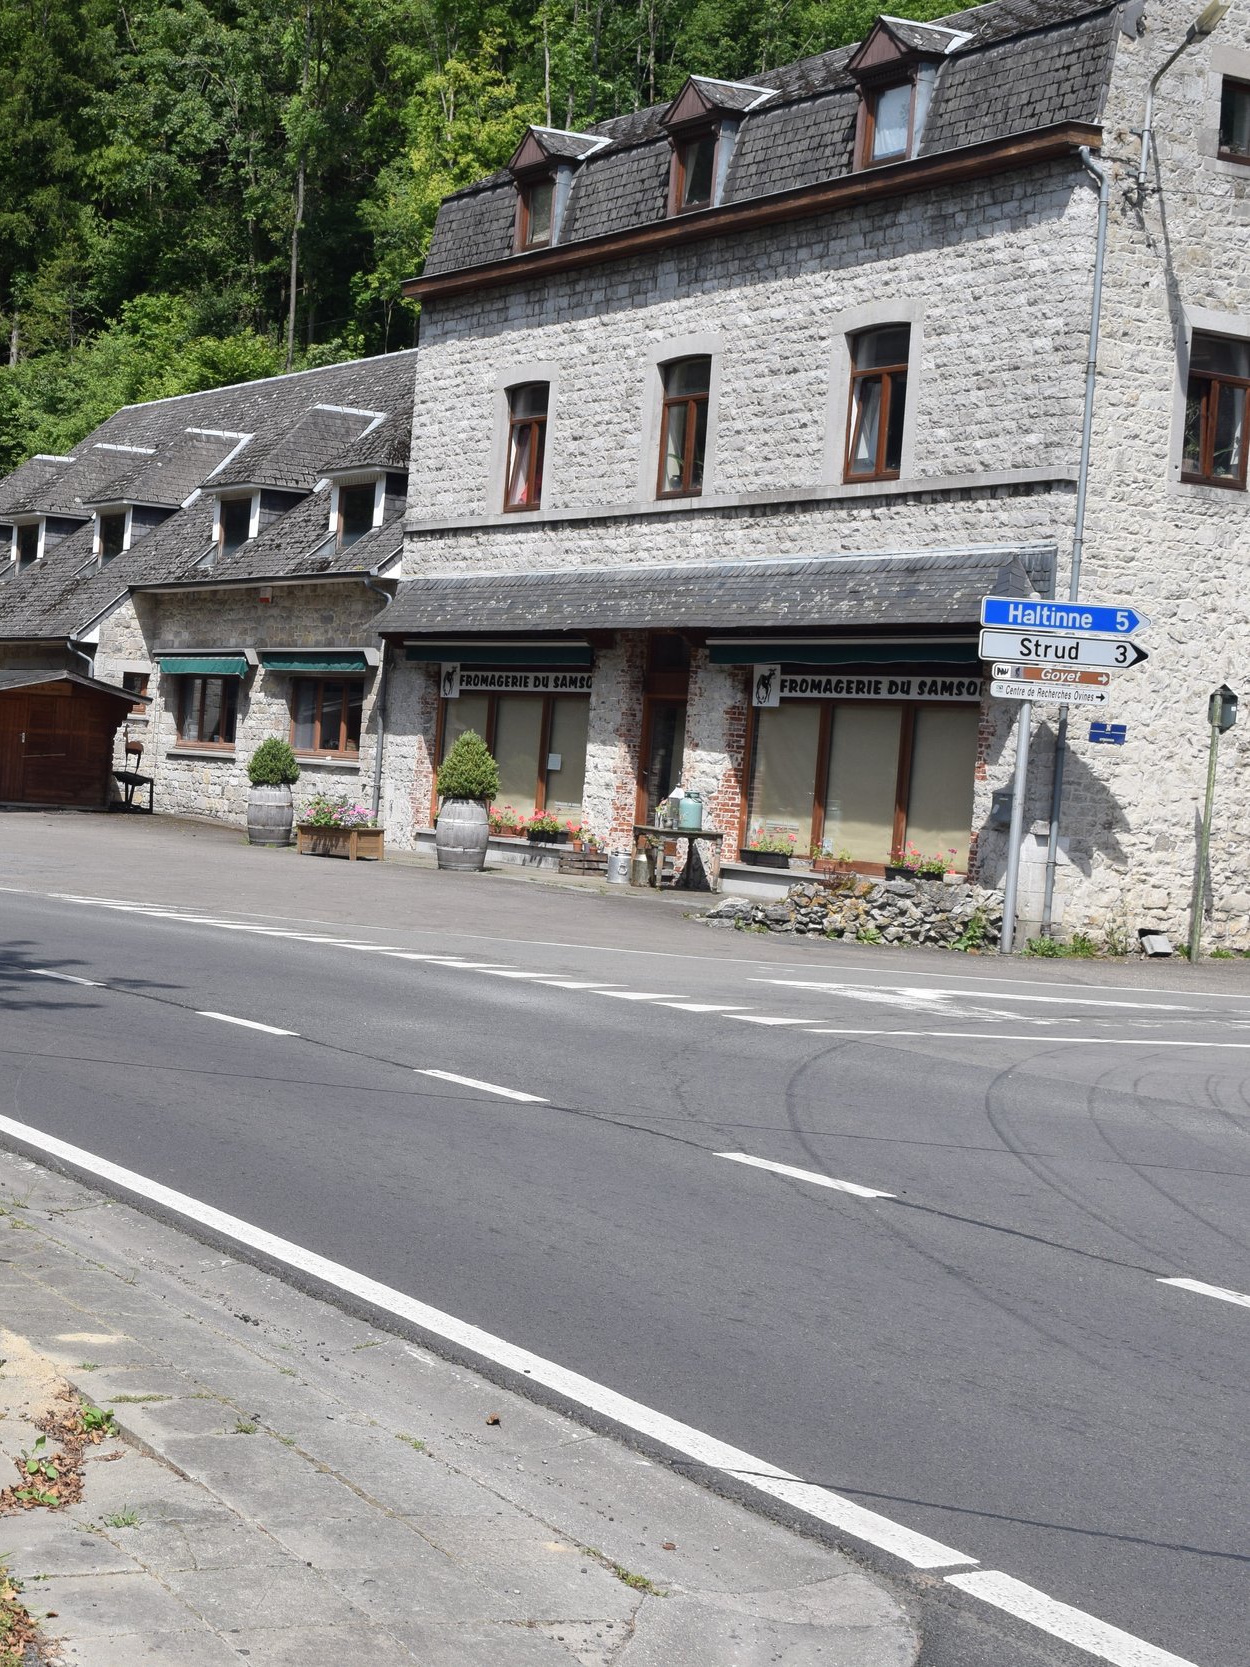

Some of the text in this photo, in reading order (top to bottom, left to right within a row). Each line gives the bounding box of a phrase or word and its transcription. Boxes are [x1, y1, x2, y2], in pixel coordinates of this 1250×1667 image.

[1008, 603, 1129, 631] Haltinne 5
[1019, 637, 1128, 664] Strud 3
[459, 674, 530, 688] FROMAGERIE
[533, 675, 549, 689] DU
[1041, 668, 1081, 683] Goyet
[780, 678, 883, 696] FROMAGERIE
[887, 680, 912, 696] DU
[1005, 685, 1095, 701] Centre de Recherches Ovines
